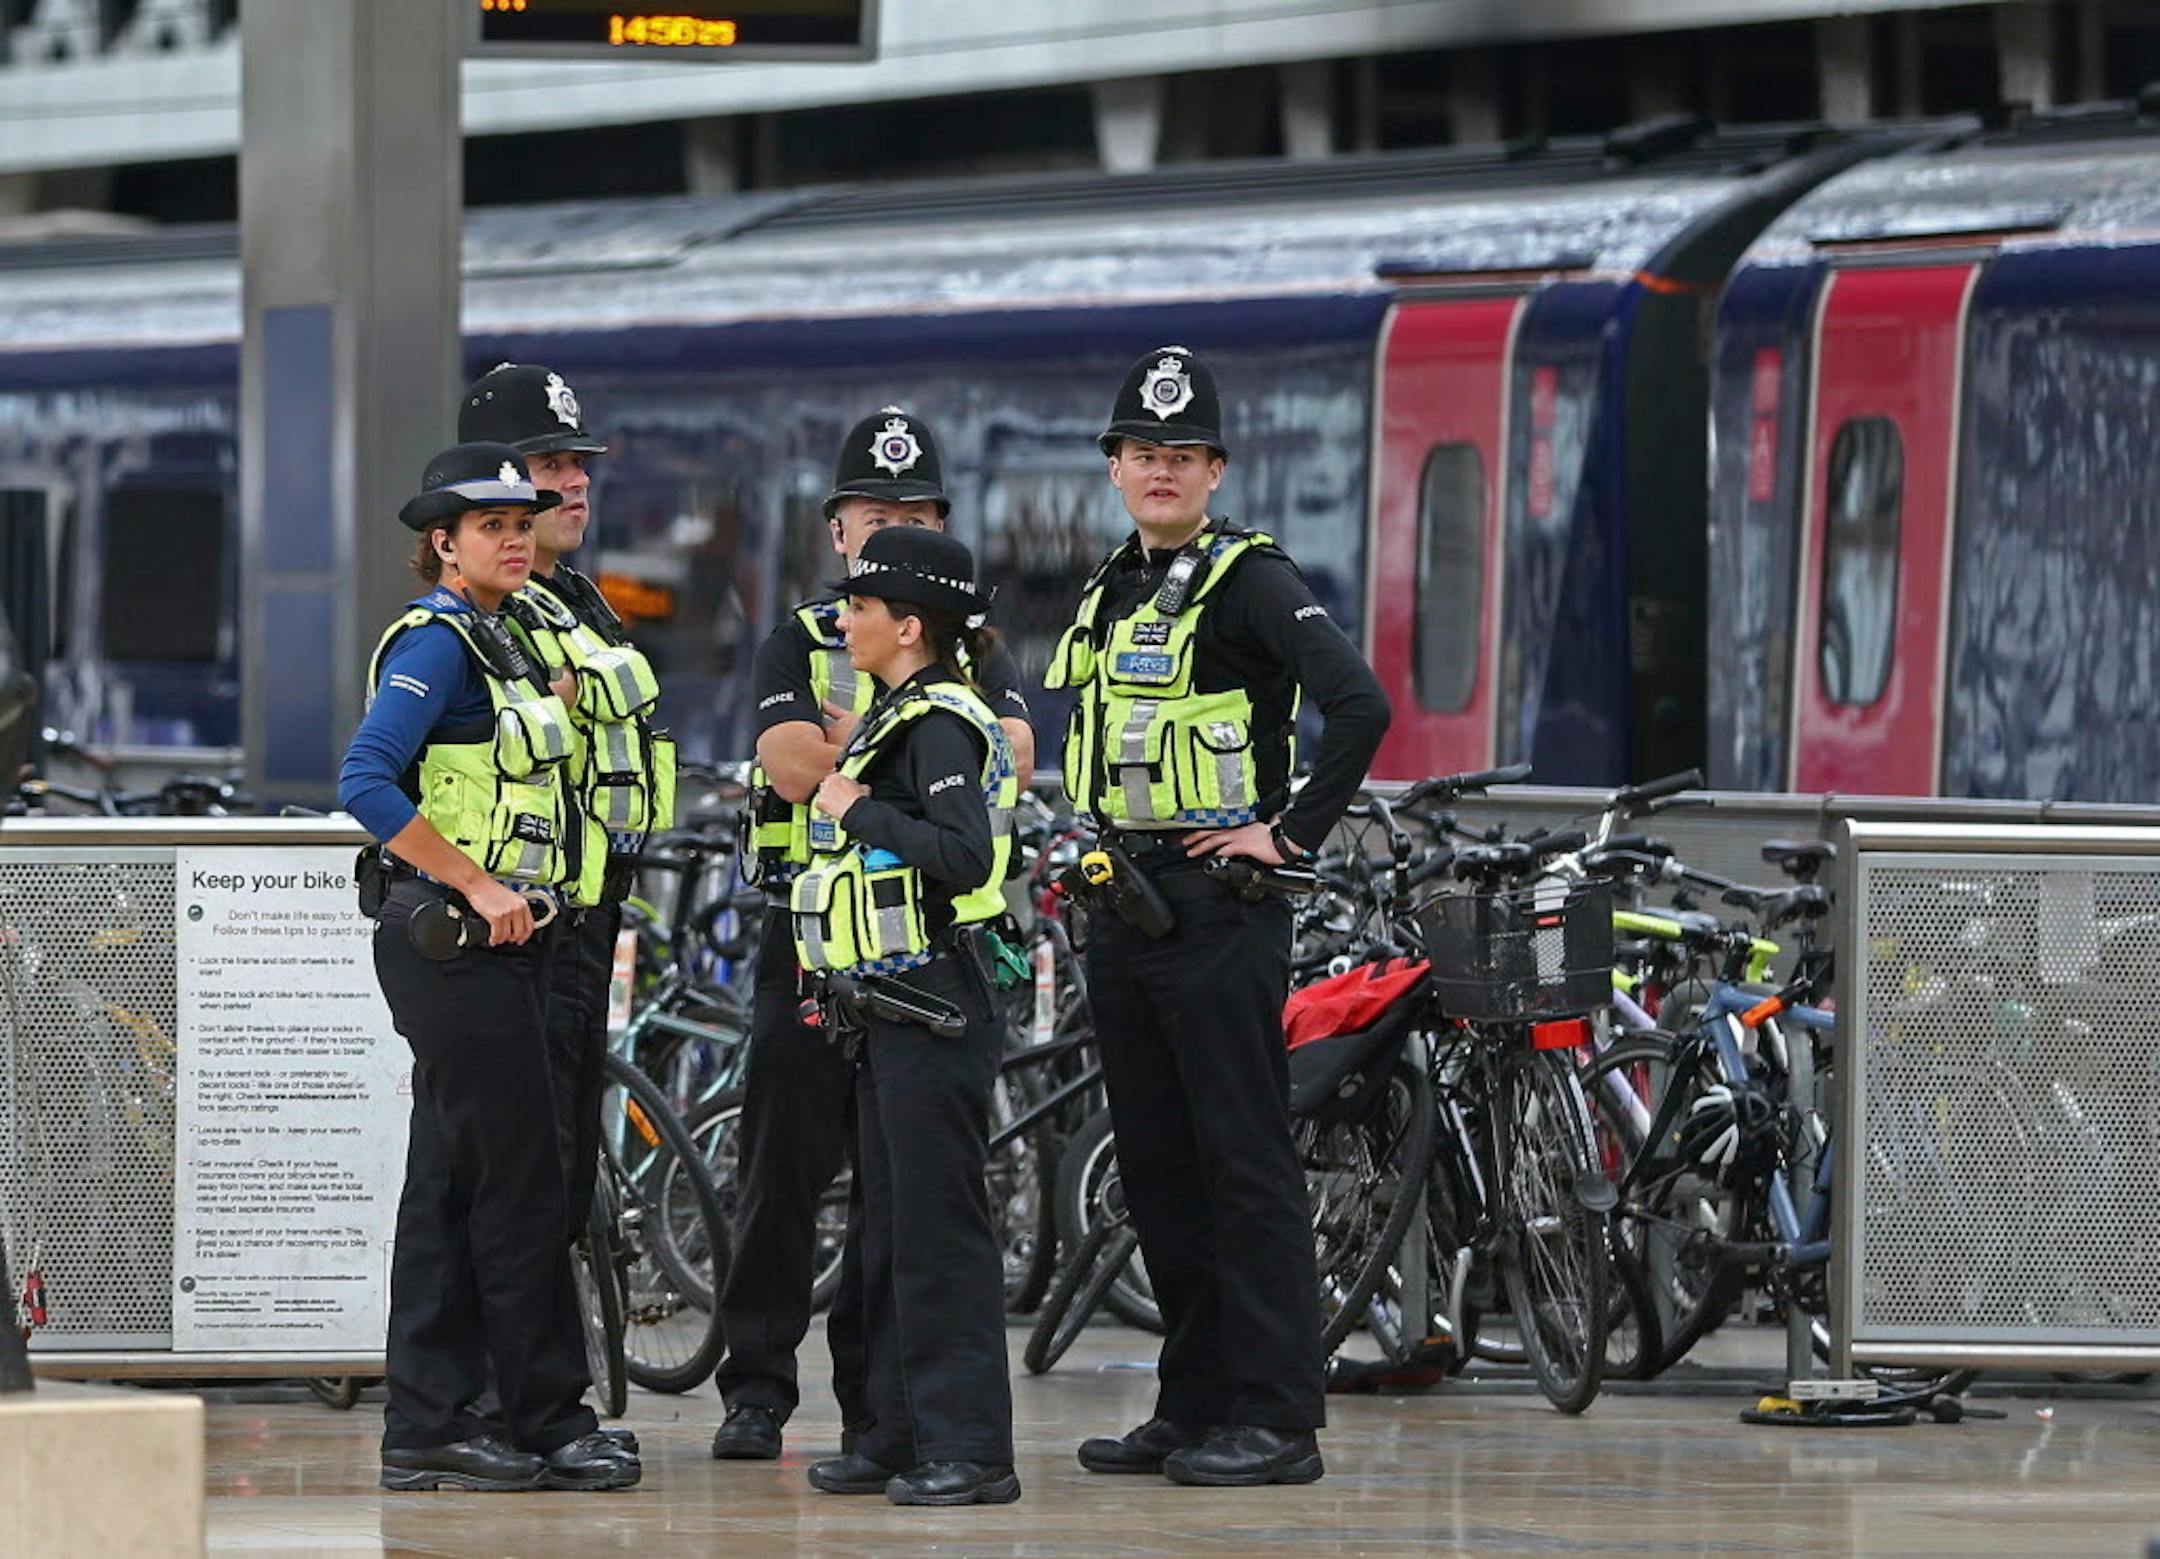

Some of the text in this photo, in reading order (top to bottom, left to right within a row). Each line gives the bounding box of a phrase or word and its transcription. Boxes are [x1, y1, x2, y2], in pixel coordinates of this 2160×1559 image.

[1130, 661, 1168, 672] POLICE
[759, 690, 795, 711] POLICE
[929, 773, 965, 797] POLICE
[192, 871, 245, 892] Keep
[252, 875, 297, 892] your
[304, 871, 346, 889] bike
[228, 910, 258, 920] Don't
[261, 910, 291, 920] make
[293, 910, 309, 920] life
[312, 912, 337, 923] easy
[340, 910, 354, 920] for
[213, 925, 248, 935] Follow
[251, 925, 281, 935] these
[284, 925, 304, 938] tips
[307, 925, 317, 935] to
[321, 925, 352, 938] guard
[198, 1035, 229, 1045] contact
[232, 1035, 248, 1044] with
[251, 1035, 263, 1044] the
[266, 1035, 295, 1046] ground
[310, 1035, 337, 1045] they're
[340, 1035, 376, 1046] touching
[198, 1069, 214, 1080] Buy
[224, 1069, 251, 1079] decent
[254, 1069, 270, 1079] lock
[279, 1071, 287, 1079] or
[290, 1069, 329, 1080] preferably
[333, 1069, 348, 1079] two
[198, 1103, 279, 1115] lock security ratings
